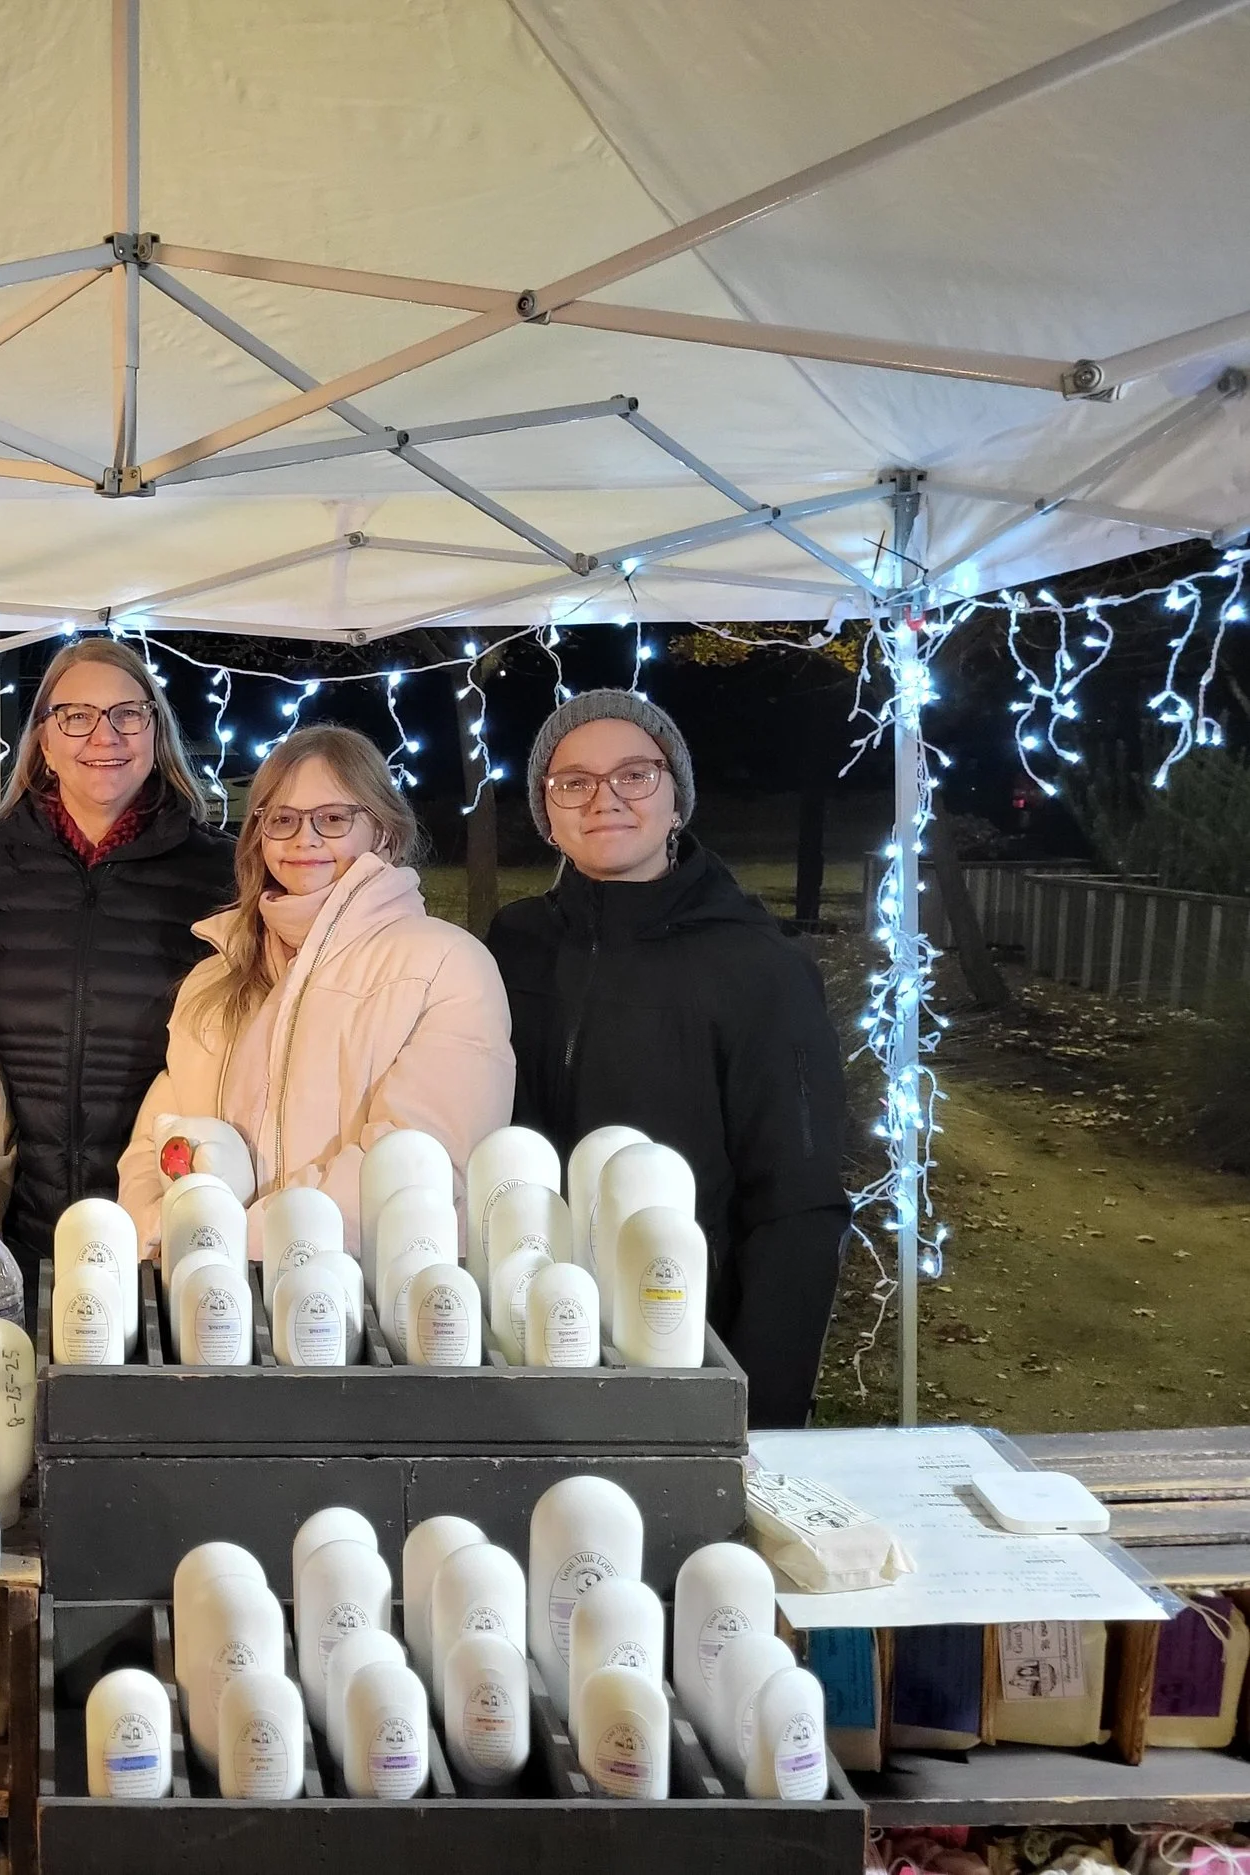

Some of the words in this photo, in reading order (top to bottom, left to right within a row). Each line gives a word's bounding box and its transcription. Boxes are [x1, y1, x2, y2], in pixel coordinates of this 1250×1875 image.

[559, 1563, 575, 1581] Goat
[575, 1554, 594, 1565] Milk
[596, 1556, 613, 1577] Lotio
